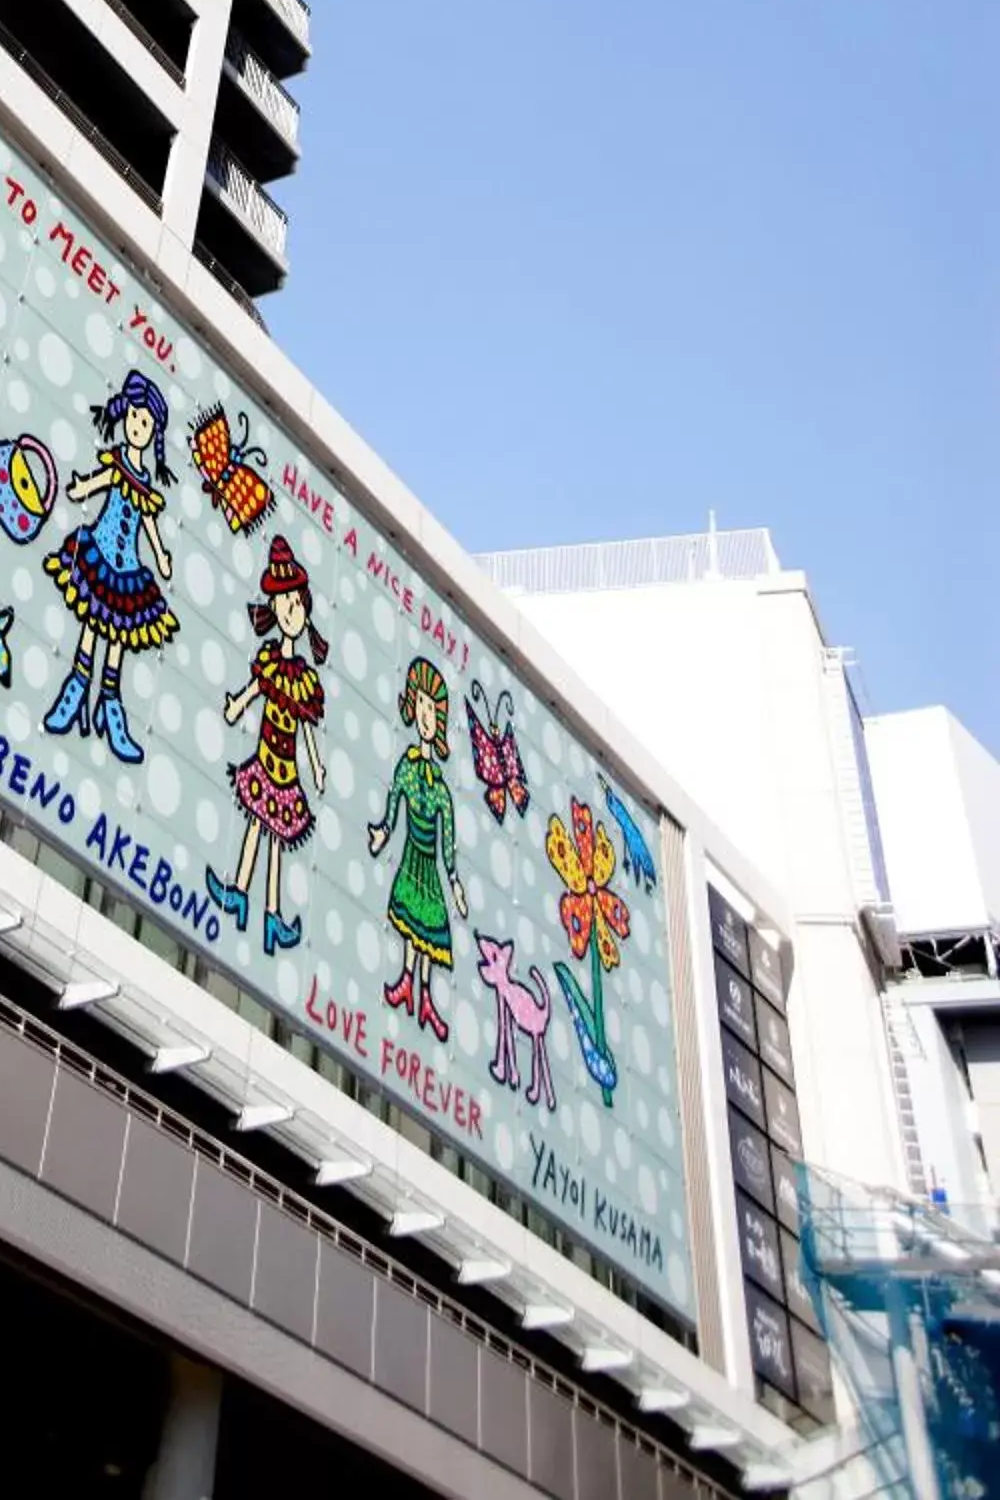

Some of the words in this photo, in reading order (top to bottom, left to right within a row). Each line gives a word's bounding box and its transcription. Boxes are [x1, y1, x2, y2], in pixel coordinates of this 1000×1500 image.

[5, 176, 38, 225] TO
[48, 221, 120, 305] MEET
[129, 303, 176, 373] YOU.
[282, 463, 335, 533] HAVE
[343, 527, 359, 558] A
[366, 550, 414, 614] NICE
[420, 604, 469, 671] DAY!
[85, 812, 220, 942] AKEBONO
[305, 974, 368, 1058] LOVE
[380, 1038, 483, 1140] FOREVER
[529, 1131, 586, 1219] YAYOI
[593, 1187, 664, 1274] KUSAMA
